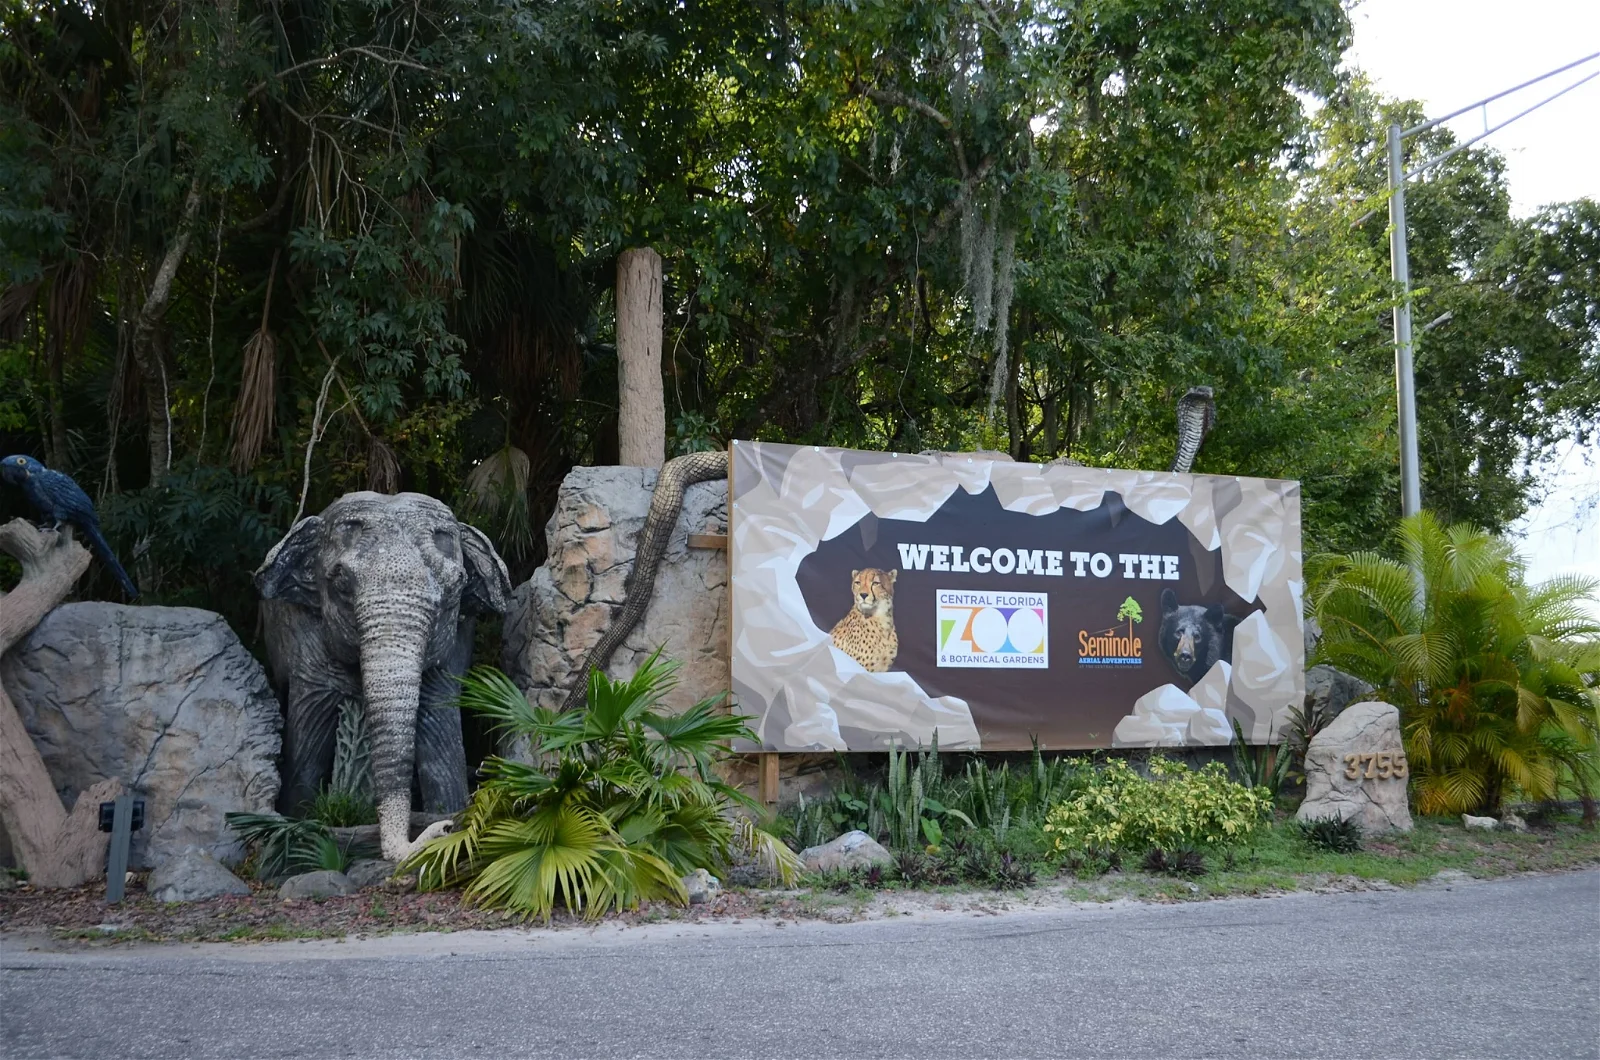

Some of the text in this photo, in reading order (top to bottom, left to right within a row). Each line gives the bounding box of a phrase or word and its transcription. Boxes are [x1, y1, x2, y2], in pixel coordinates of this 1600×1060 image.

[897, 543, 1180, 580] WELCOME TO THE
[940, 594, 1044, 606] CENTRAL FLORIDA
[940, 606, 1044, 653] ZOO
[1078, 630, 1142, 657] Seminole
[949, 655, 1000, 663] BOTANICAL
[1344, 752, 1408, 780] 3755
